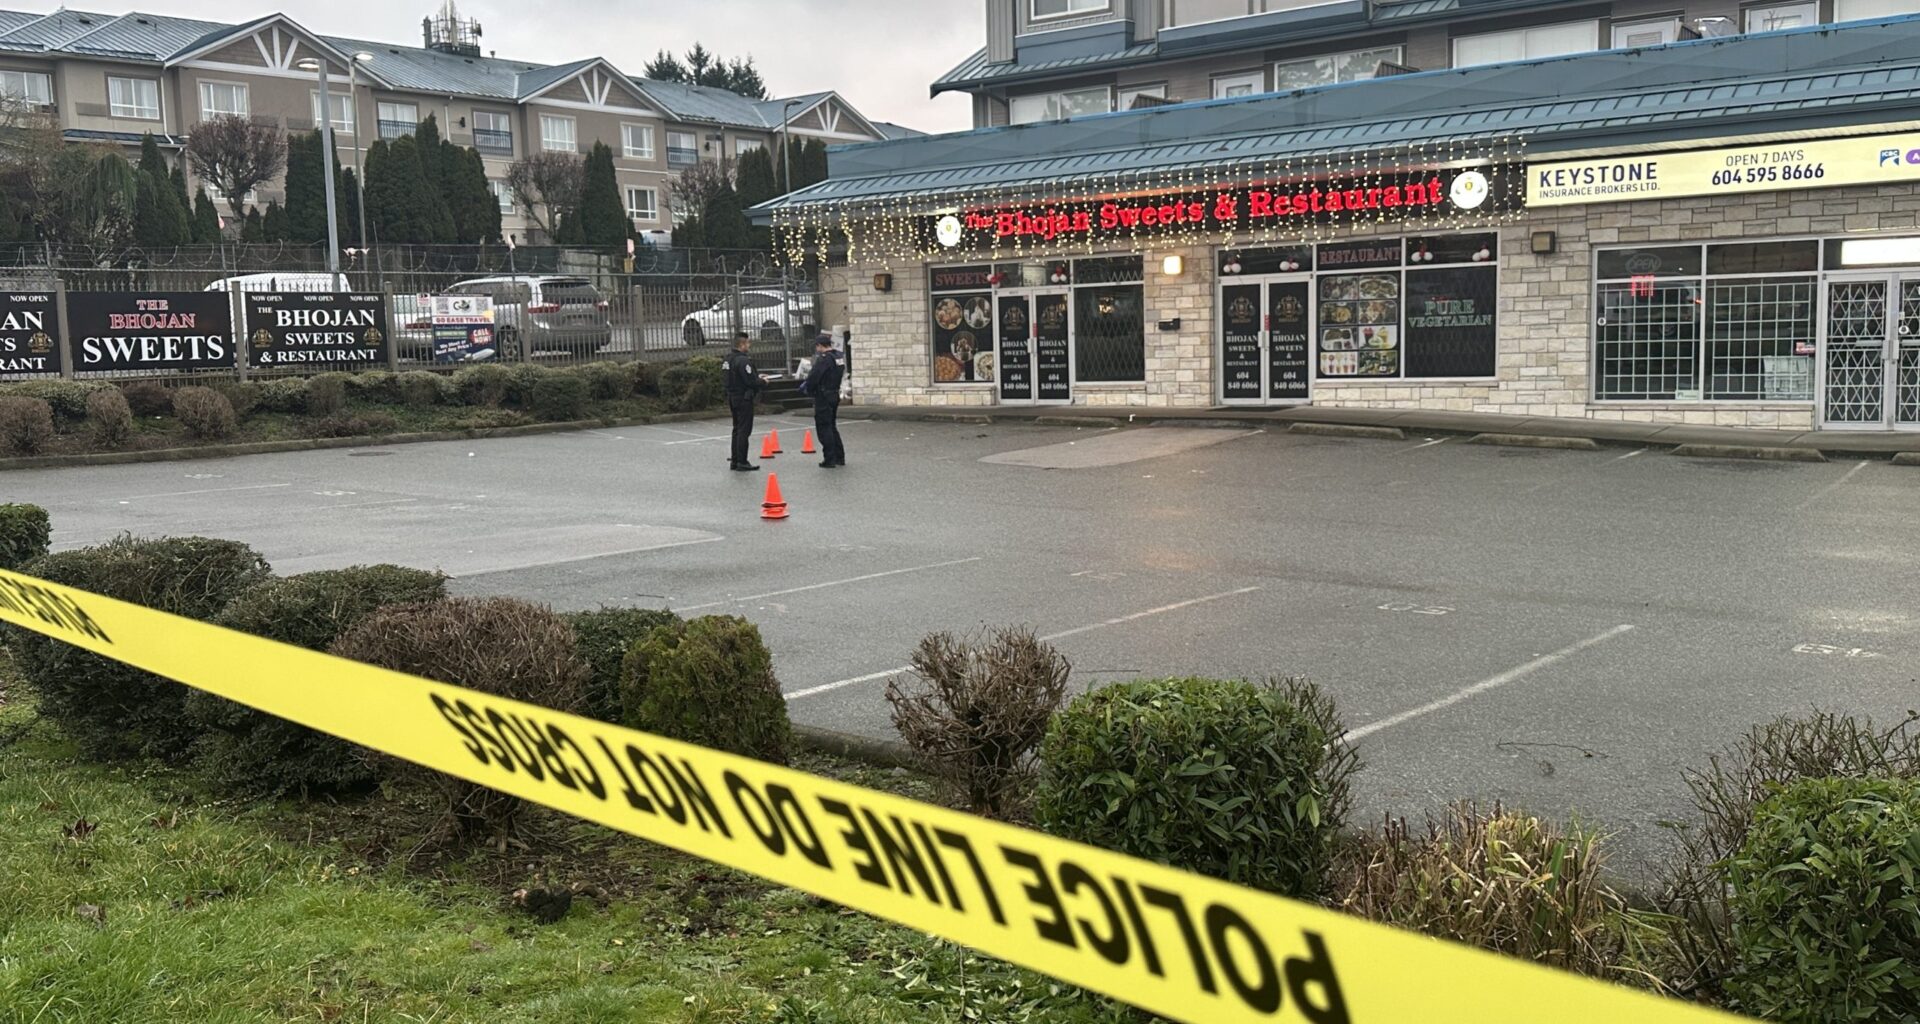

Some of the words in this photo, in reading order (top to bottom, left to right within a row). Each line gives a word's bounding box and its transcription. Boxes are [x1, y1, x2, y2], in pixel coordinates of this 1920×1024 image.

[1726, 153, 1759, 166] OPEN
[1762, 153, 1769, 164] 7
[1772, 149, 1804, 163] DAYS
[1540, 162, 1658, 188] KEYSTONE
[1712, 169, 1742, 185] 604
[1746, 166, 1777, 183] 595
[1782, 163, 1824, 180] 8666
[1539, 187, 1592, 198] INSURANCE
[1594, 183, 1638, 195] BROKERS
[1640, 182, 1660, 192] LTD.
[965, 212, 994, 229] The
[996, 209, 1092, 240] Bhojan
[1100, 200, 1204, 229] Sweets
[1213, 195, 1239, 220] &
[1249, 177, 1444, 217] Restaurant
[1319, 246, 1401, 265] RESTAURANT
[136, 300, 169, 311] THE
[1425, 299, 1475, 316] PURE
[109, 313, 196, 329] BHOJAN
[257, 306, 273, 314] THE
[276, 309, 375, 327] BHOJAN
[1408, 314, 1492, 328] VEGETARIAN
[285, 332, 355, 346] SWEETS
[1226, 335, 1258, 343] BHOJAN
[1272, 334, 1306, 342] BHOJAN
[83, 335, 224, 363] SWEETS
[260, 351, 273, 363] &
[277, 349, 377, 362] RESTAURANT
[1236, 371, 1249, 379] 604
[1283, 371, 1296, 379] 604
[430, 692, 608, 802] CROSS
[594, 735, 734, 840] NOT
[722, 769, 834, 871] DO
[816, 795, 1009, 927] LINE
[999, 844, 1352, 1024] POLICE
